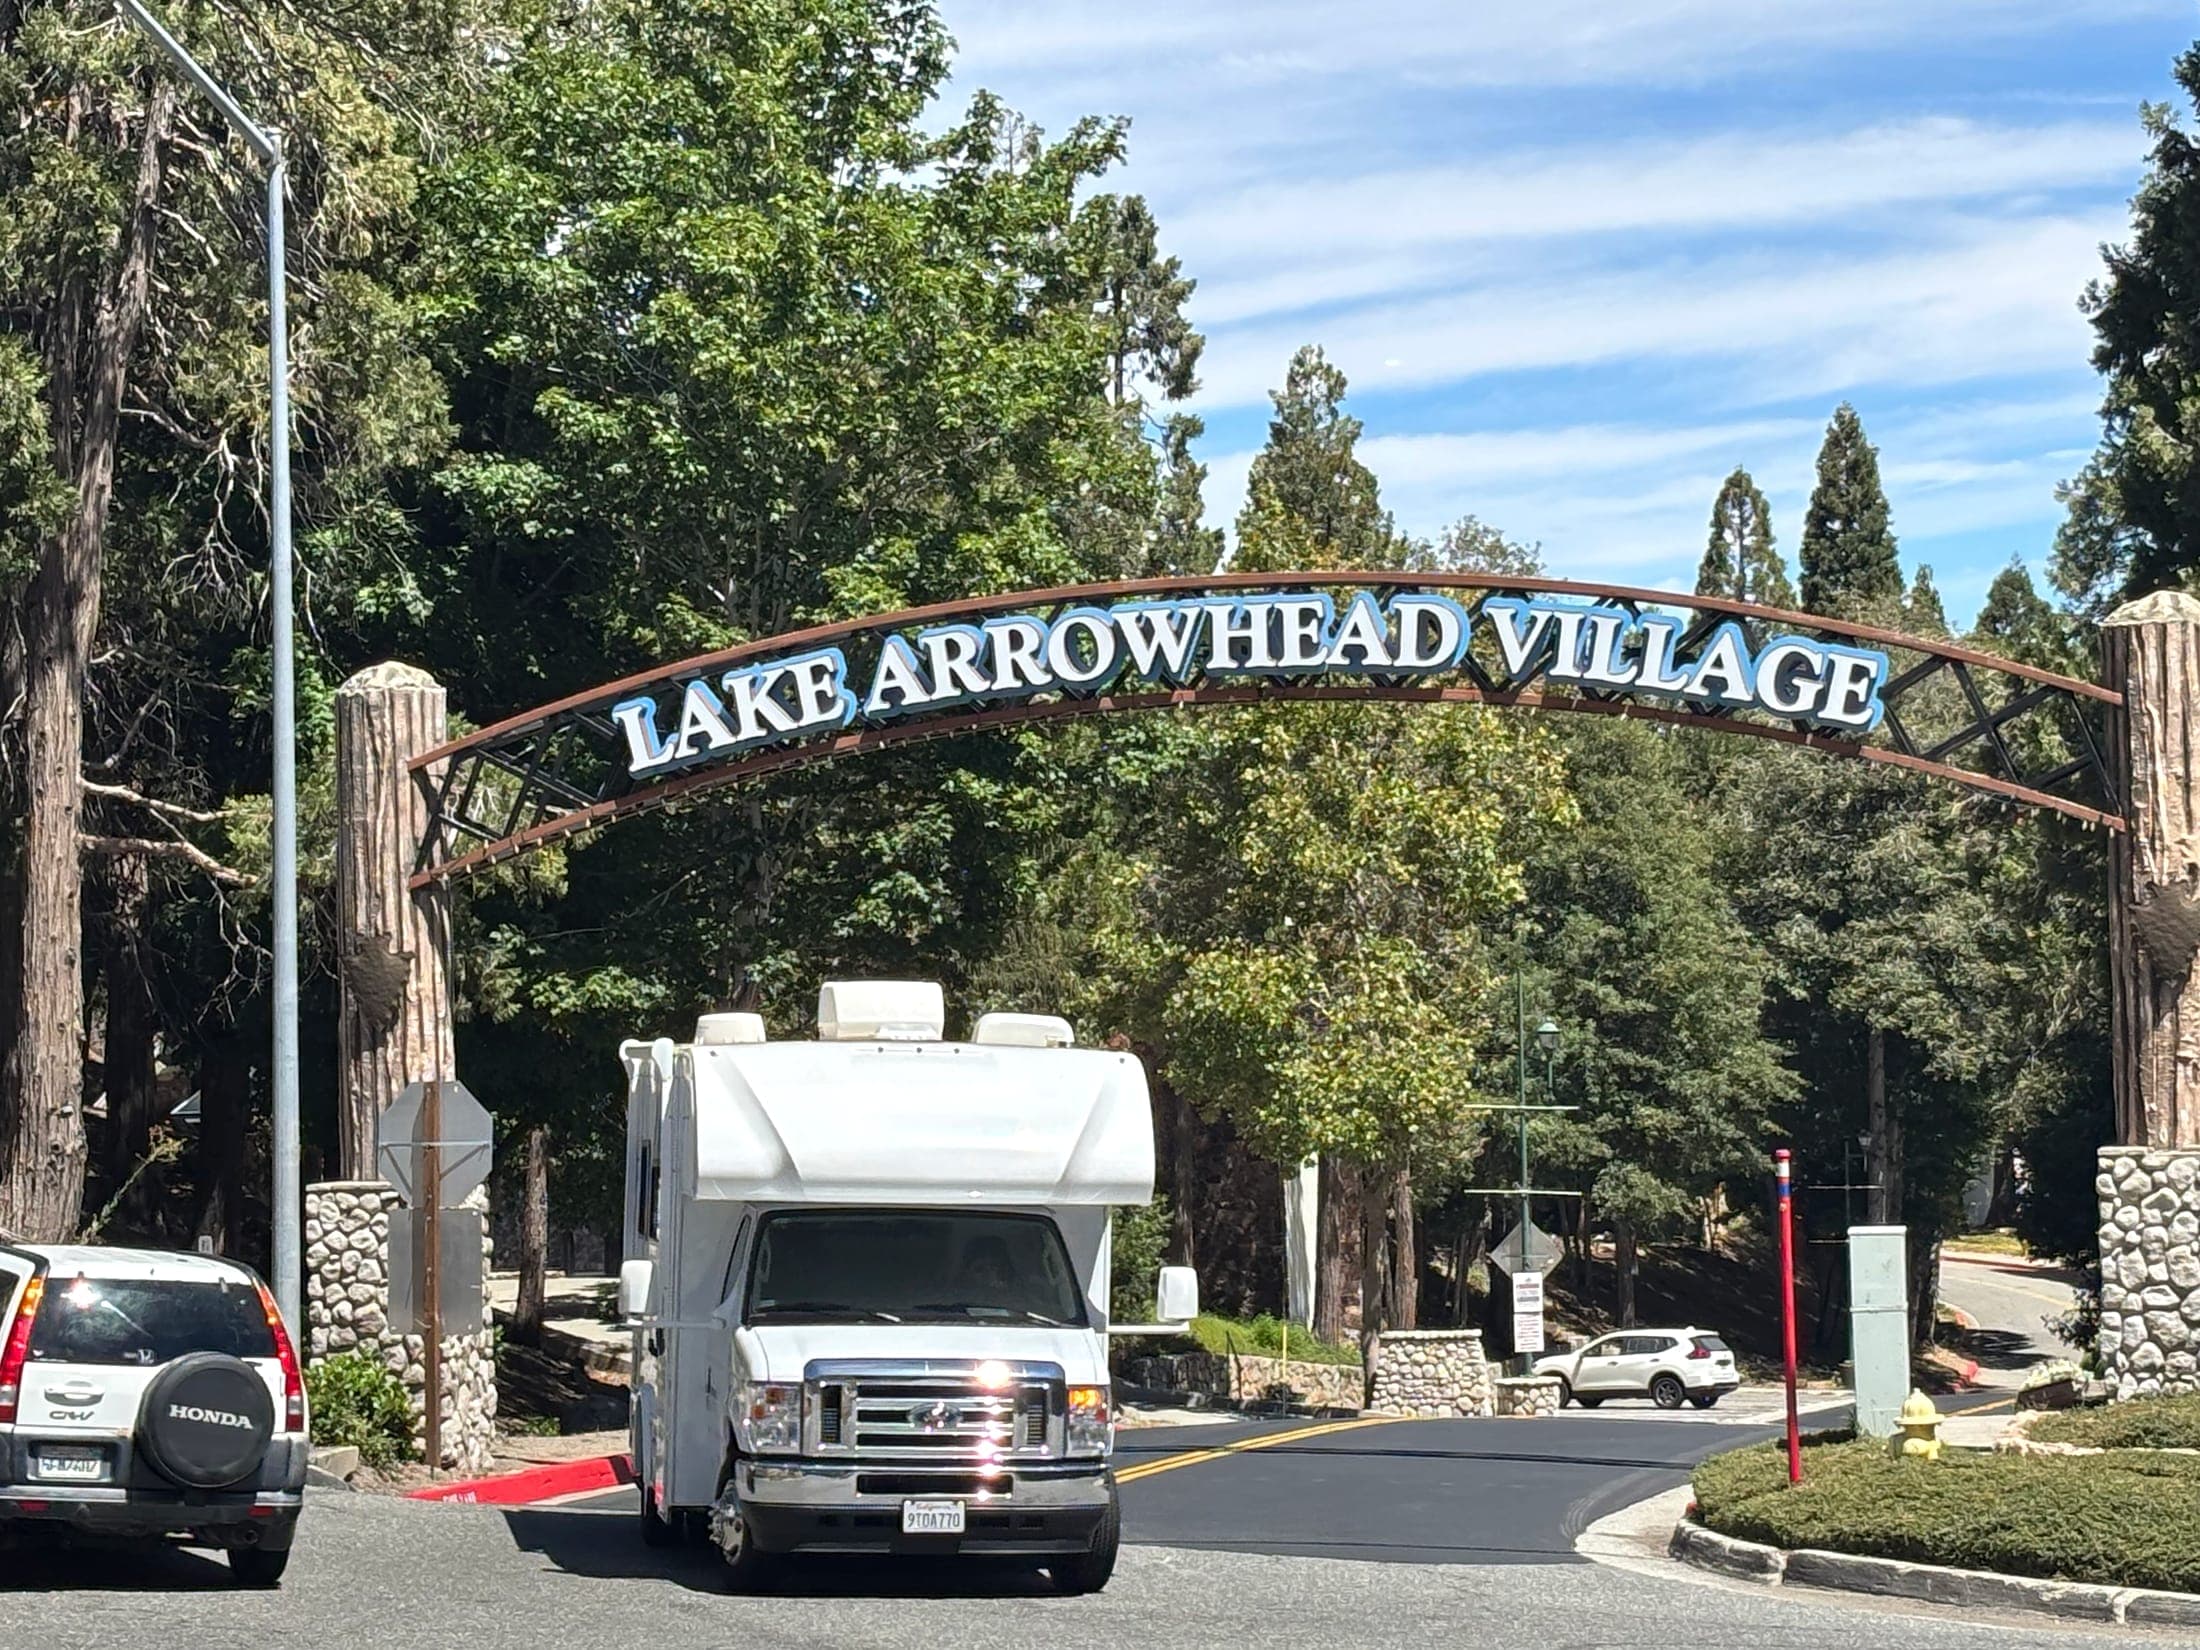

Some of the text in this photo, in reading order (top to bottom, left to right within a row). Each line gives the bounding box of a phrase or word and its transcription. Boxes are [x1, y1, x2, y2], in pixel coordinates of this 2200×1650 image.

[611, 590, 1888, 776] LAKE ARROWHEAD VILLAGE
[169, 1404, 253, 1430] HONDA
